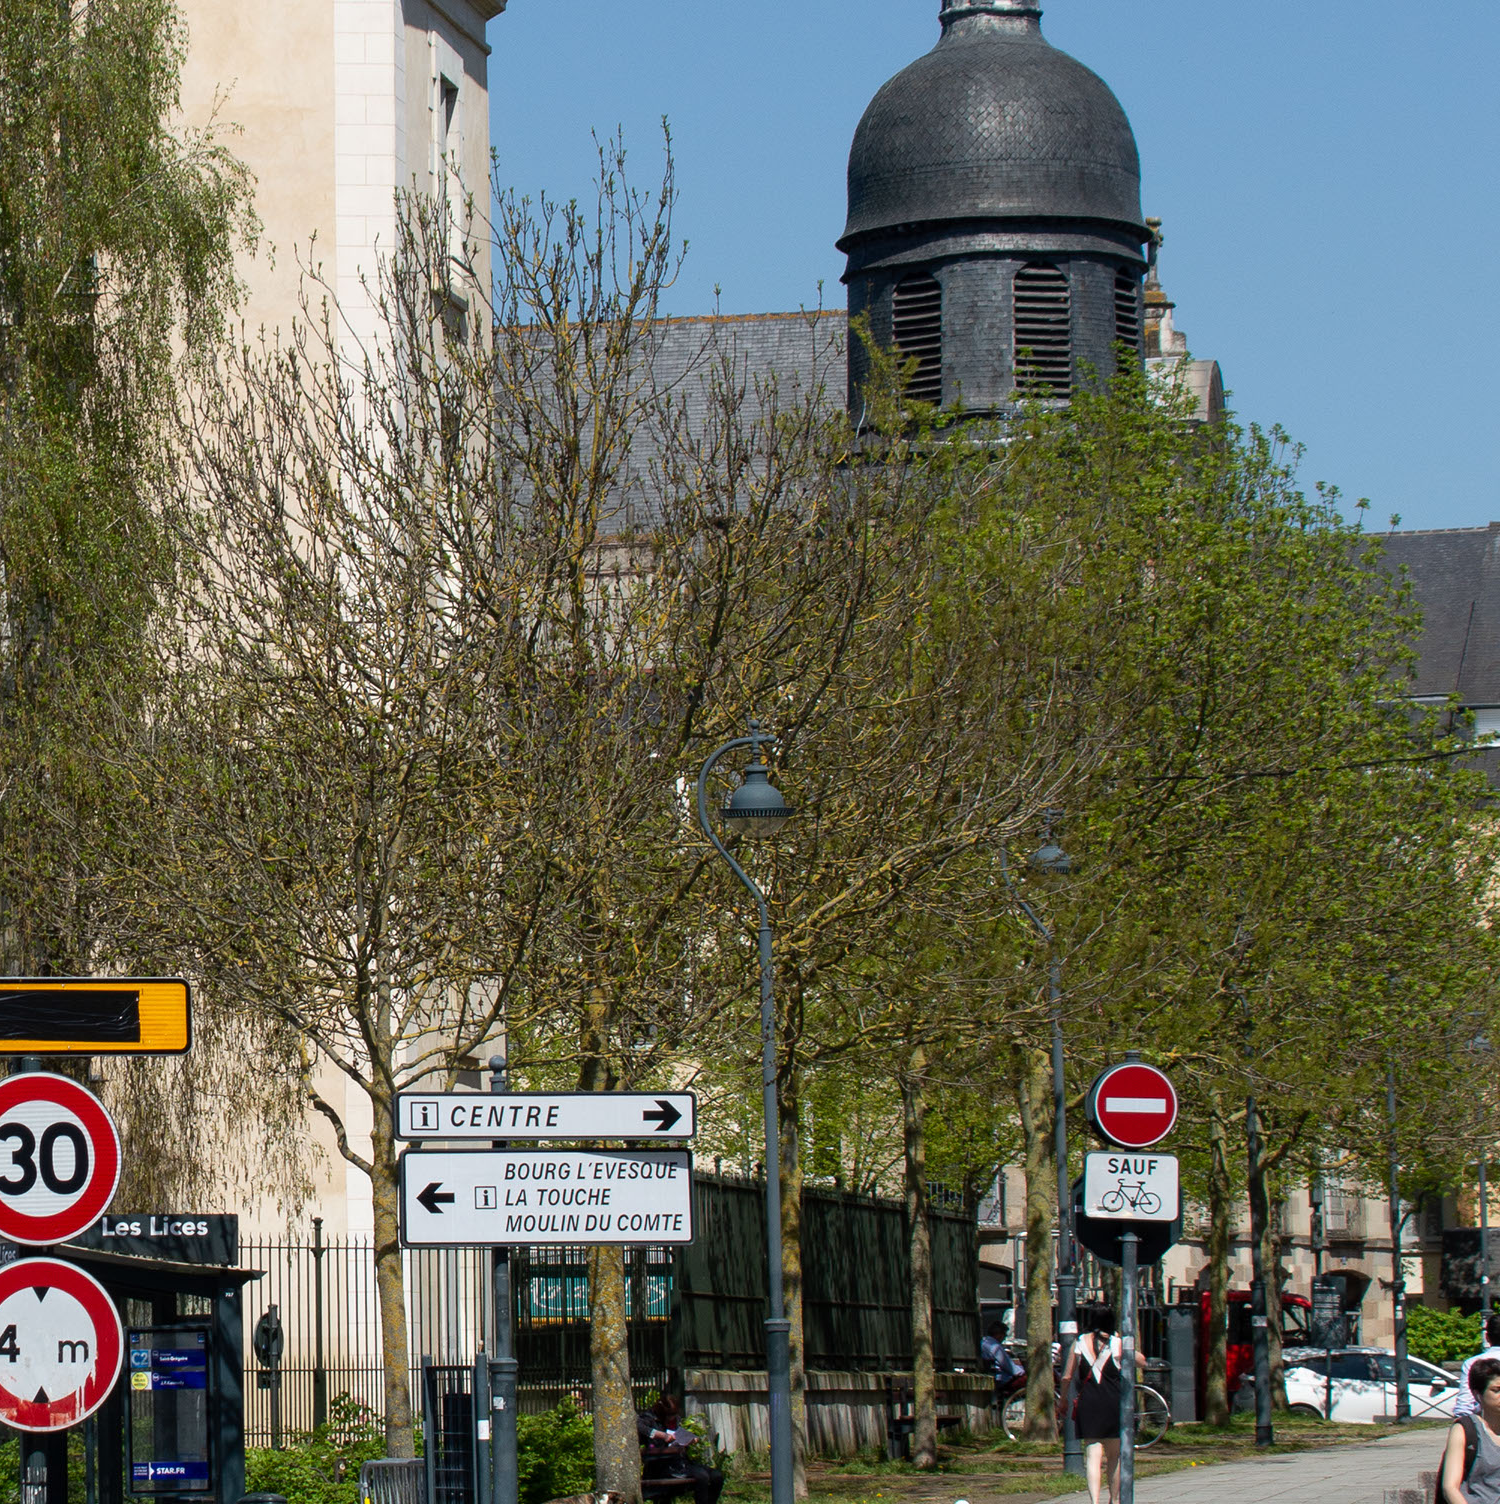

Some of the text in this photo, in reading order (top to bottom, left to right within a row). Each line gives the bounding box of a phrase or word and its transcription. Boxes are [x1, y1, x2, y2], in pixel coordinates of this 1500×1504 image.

[450, 1105, 559, 1127] CENTRE
[504, 1162, 678, 1180] BOURG L'EVESQUE
[1107, 1158, 1158, 1175] SAUF
[505, 1188, 611, 1206] LA TOUCHE
[102, 1216, 209, 1236] Les Lices
[506, 1214, 683, 1232] MOULIN DU COMTE
[57, 1339, 89, 1363] m
[131, 1351, 149, 1366] C2
[156, 1467, 186, 1475] STAR.FR
